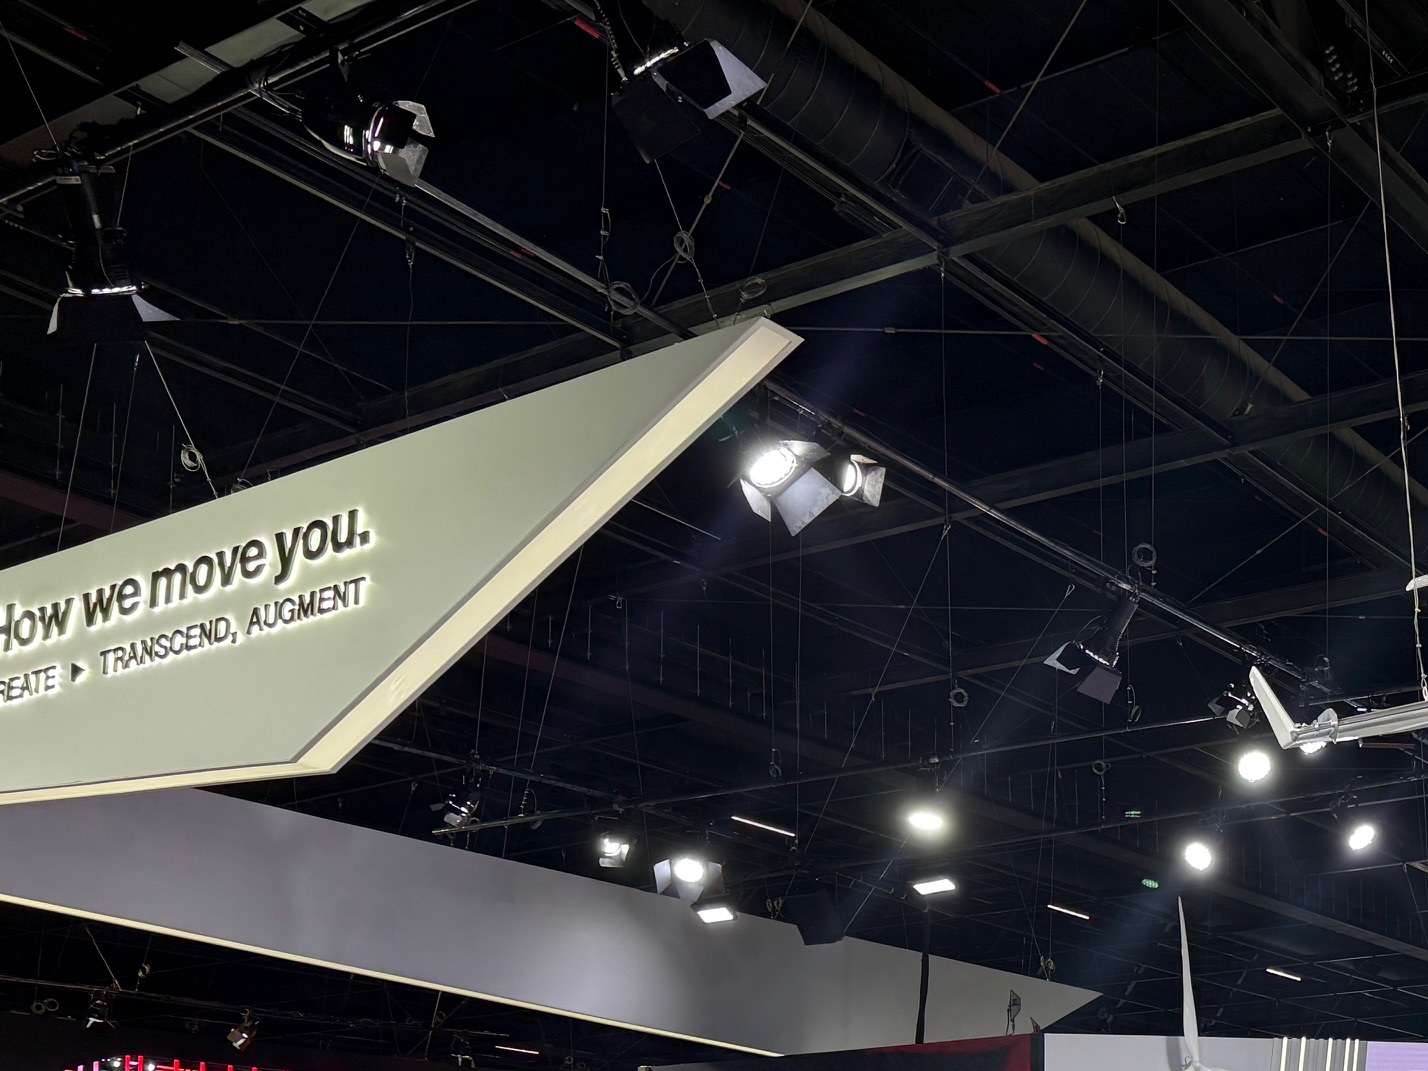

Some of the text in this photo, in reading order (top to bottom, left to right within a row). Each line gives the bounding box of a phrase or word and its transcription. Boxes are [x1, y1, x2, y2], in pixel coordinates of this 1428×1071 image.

[82, 577, 142, 628] we
[150, 538, 267, 609] move
[274, 508, 371, 586] you.
[99, 616, 238, 675] TRANSCEND,
[246, 577, 367, 635] AUGMENT
